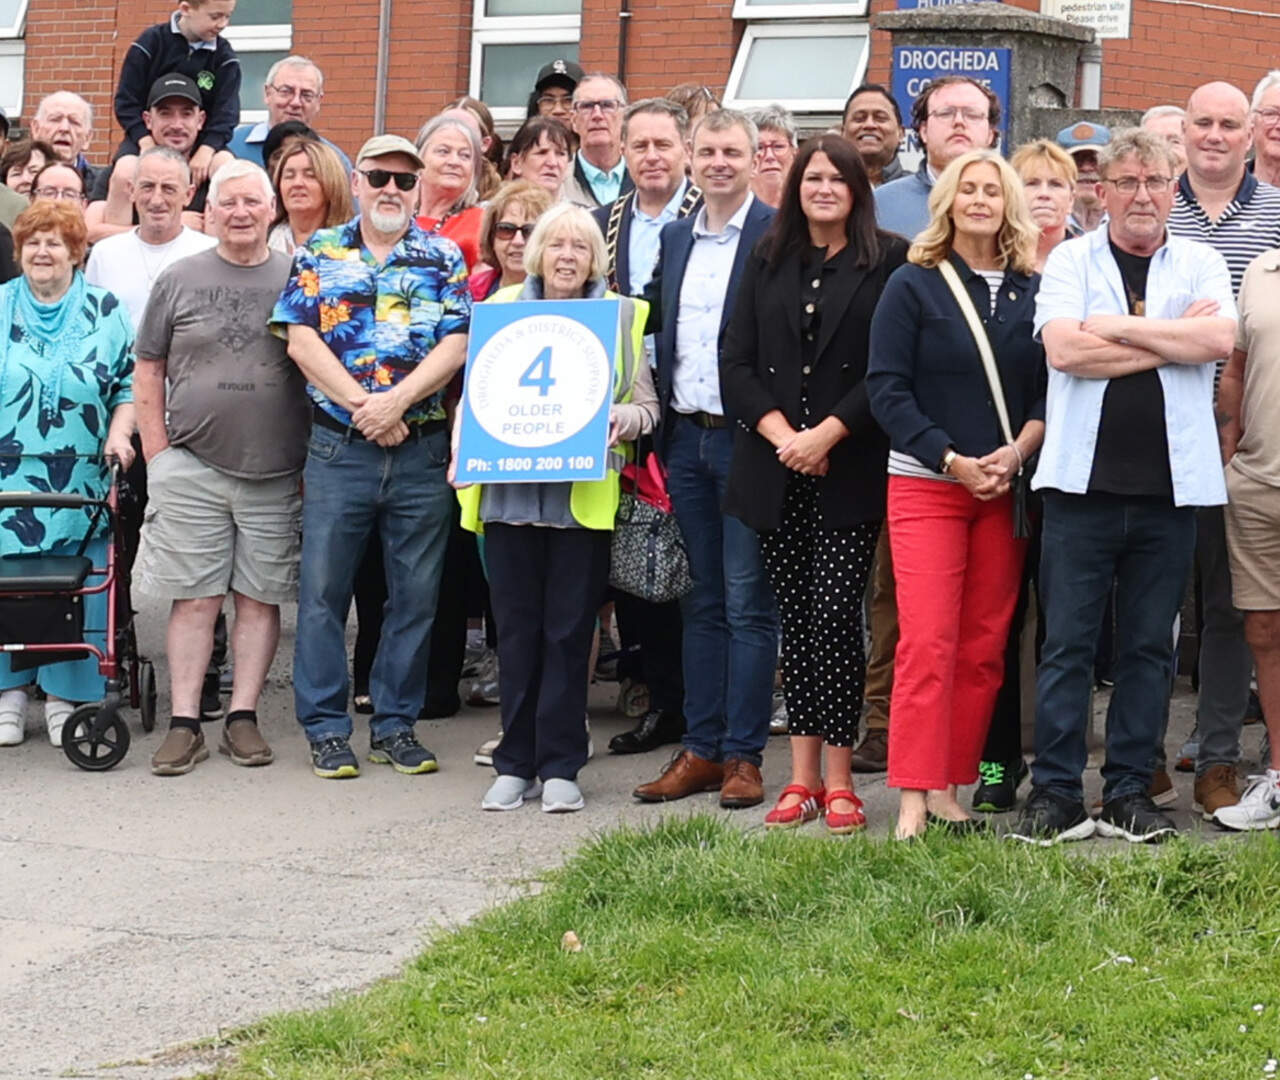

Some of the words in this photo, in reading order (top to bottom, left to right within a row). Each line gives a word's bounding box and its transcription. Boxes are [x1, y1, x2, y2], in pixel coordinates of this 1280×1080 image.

[1061, 2, 1107, 13] pedestrian
[1109, 1, 1125, 11] site
[1066, 14, 1095, 23] Please
[1097, 13, 1119, 23] drive
[900, 50, 999, 71] DROGHEDA
[527, 322, 586, 346] DISTRICT
[518, 345, 557, 397] 4
[508, 403, 563, 417] OLDER
[502, 421, 566, 435] PEOPLE
[466, 456, 493, 472] Ph:
[496, 457, 533, 472] 1800
[535, 456, 564, 471] 200
[568, 456, 594, 470] 100
